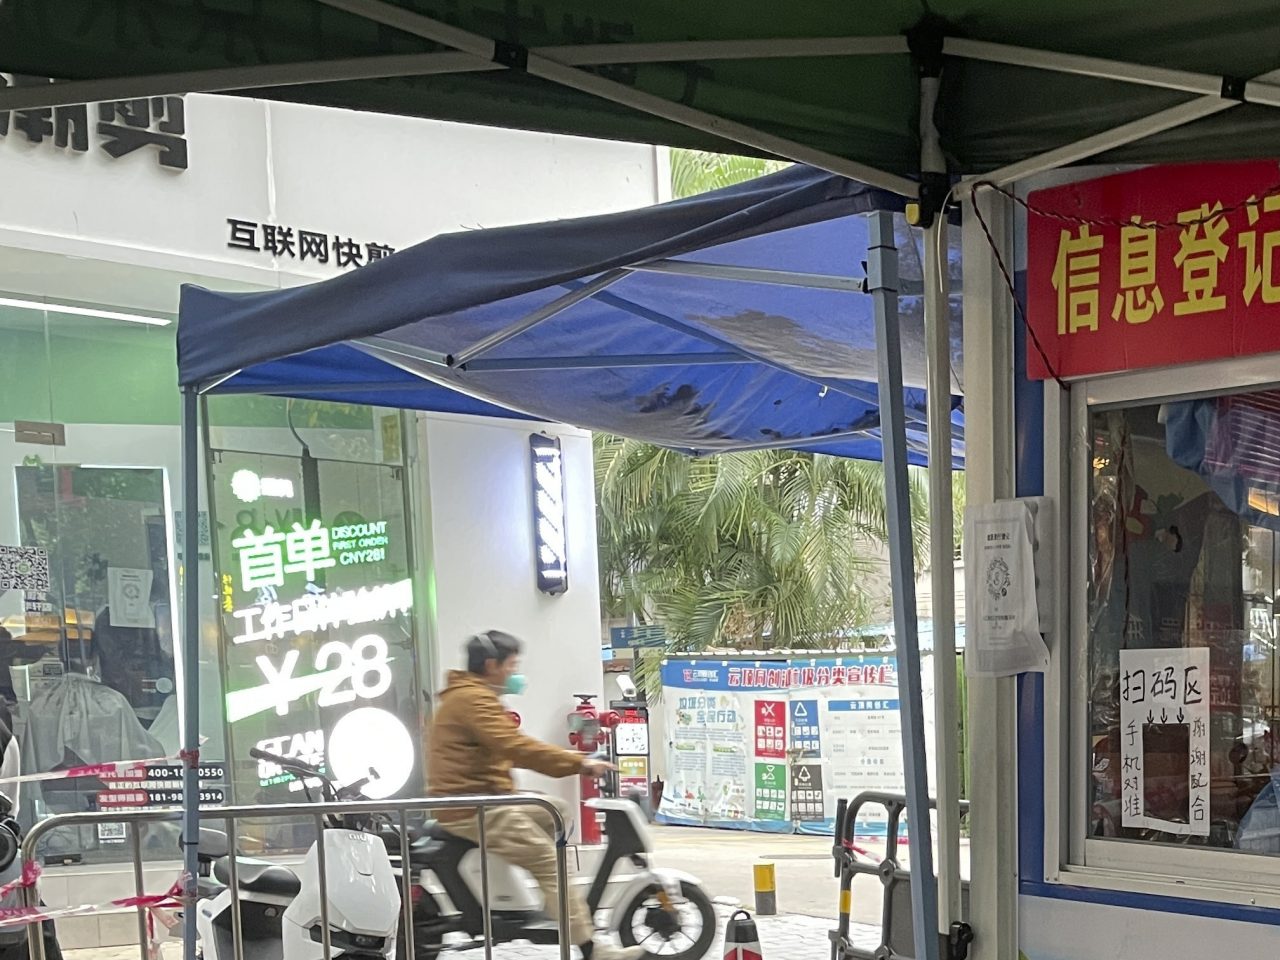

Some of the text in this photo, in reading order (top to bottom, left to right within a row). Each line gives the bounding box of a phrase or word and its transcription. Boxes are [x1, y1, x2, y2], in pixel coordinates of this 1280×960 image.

[232, 518, 336, 592] 首单
[331, 521, 387, 539] DISCOUNT
[1122, 666, 1202, 705] 扫码区
[1122, 719, 1142, 818] 手机对准
[1190, 716, 1208, 821] 谢谢配合
